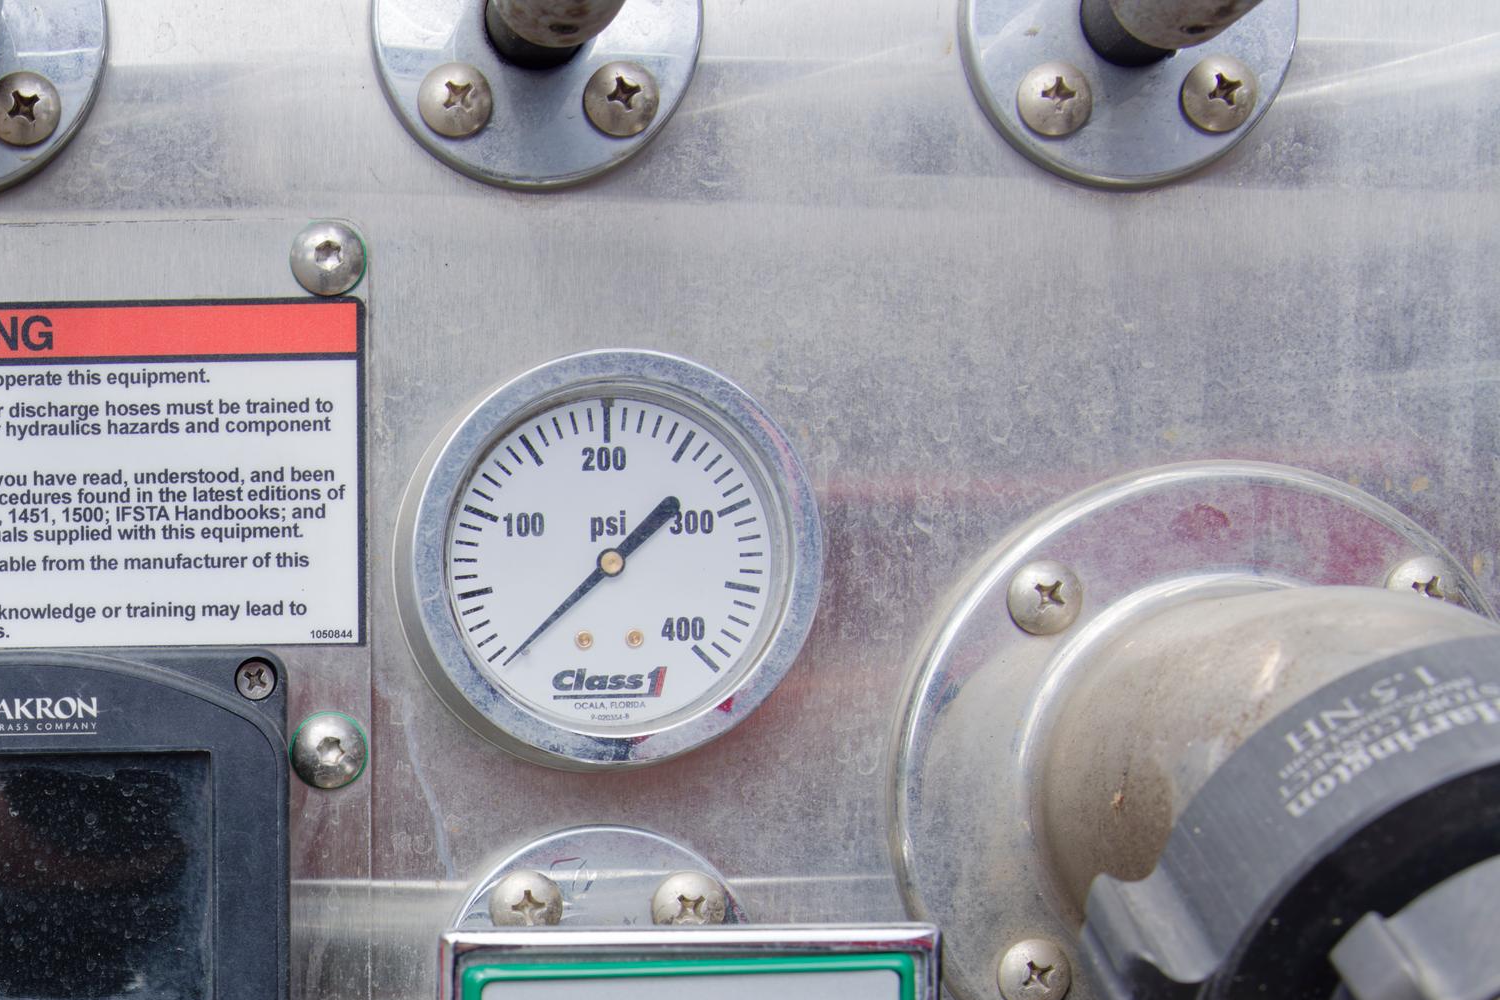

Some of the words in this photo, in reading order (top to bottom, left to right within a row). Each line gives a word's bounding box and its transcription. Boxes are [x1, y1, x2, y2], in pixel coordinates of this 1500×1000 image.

[66, 370, 101, 385] this
[106, 368, 210, 388] equipment.
[8, 402, 99, 420] discharge
[105, 401, 160, 416] hoses
[166, 400, 214, 415] must
[218, 399, 240, 414] be
[245, 397, 309, 414] trained
[315, 398, 333, 412] to
[581, 446, 627, 471] 200
[8, 508, 55, 525] 1451,
[62, 507, 109, 524] 1500;
[116, 506, 170, 522] IFSTA
[175, 504, 285, 521] Handbooks;
[291, 503, 325, 519] and
[503, 512, 545, 537] 100
[669, 510, 714, 535] 300
[590, 510, 626, 542] psi
[311, 629, 352, 639] 1050844
[661, 616, 705, 641] 400
[610, 700, 646, 709] FLORIDA
[36, 722, 97, 730] COMPANY
